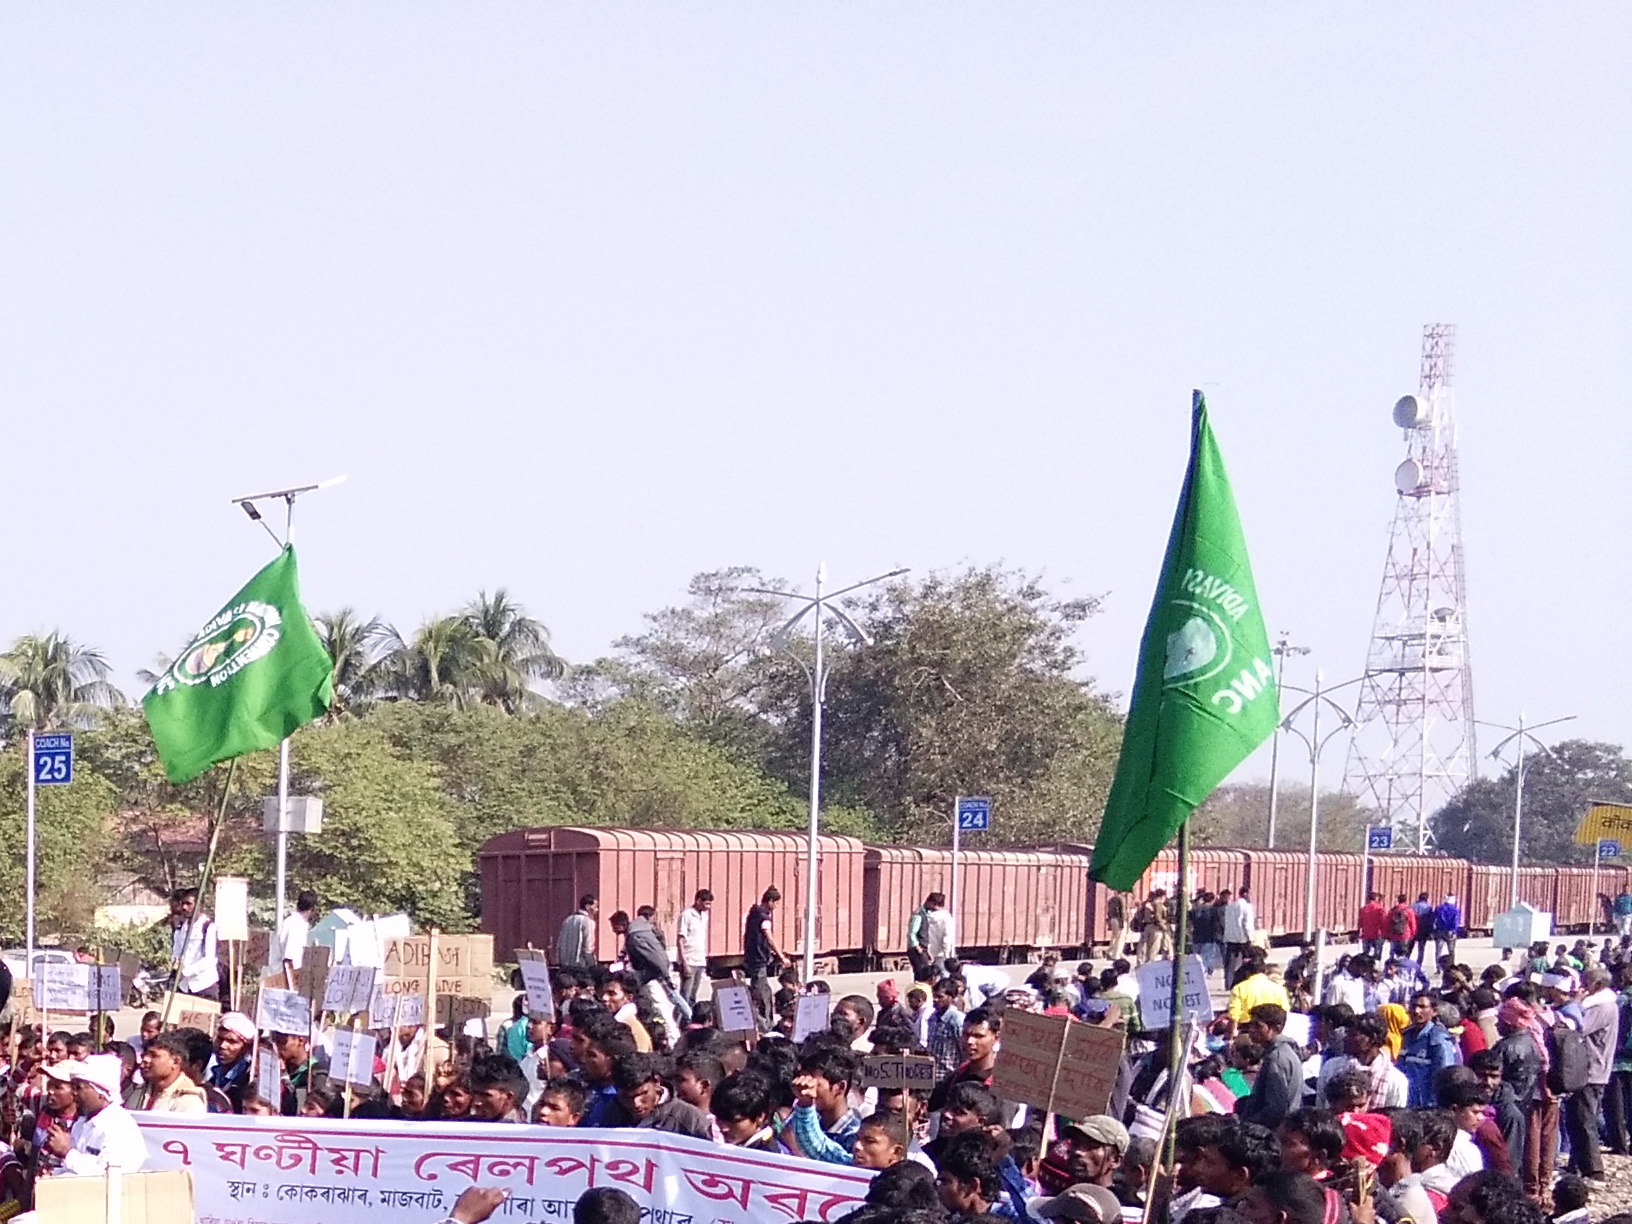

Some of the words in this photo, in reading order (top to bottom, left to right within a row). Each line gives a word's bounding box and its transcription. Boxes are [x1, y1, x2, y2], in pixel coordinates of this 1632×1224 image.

[39, 755, 67, 780] 25
[962, 812, 984, 827] 24
[1371, 836, 1389, 847] 23
[1601, 847, 1616, 856] 22
[385, 980, 420, 995] LONG
